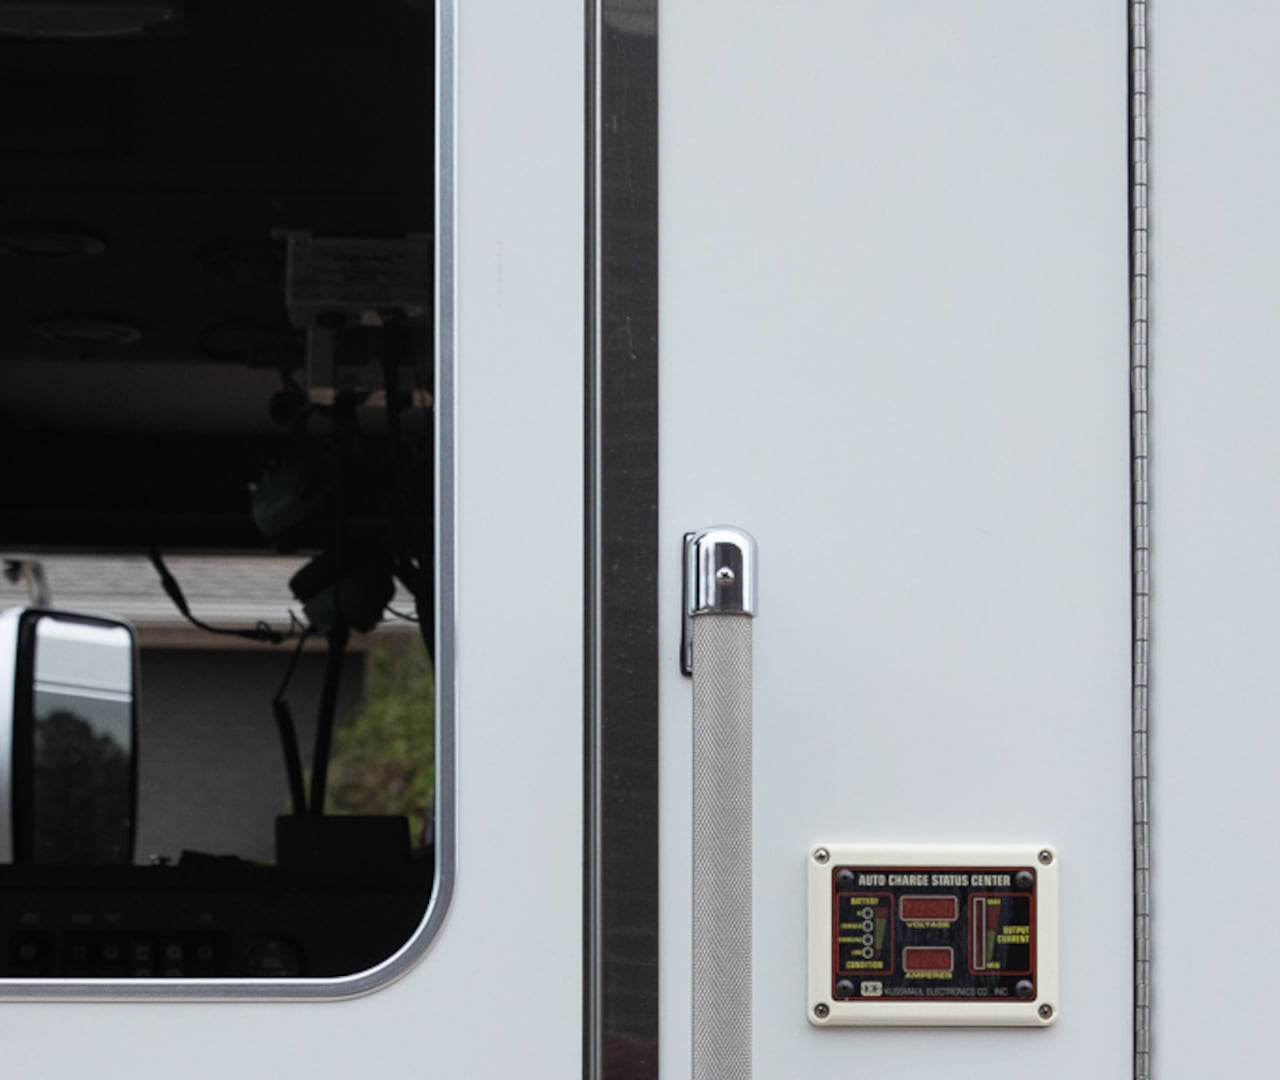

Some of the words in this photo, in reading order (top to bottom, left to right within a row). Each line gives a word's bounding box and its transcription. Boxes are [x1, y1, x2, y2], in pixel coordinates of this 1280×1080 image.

[858, 874, 887, 886] AUTO
[888, 874, 929, 886] CHARGE
[932, 874, 969, 886] STATUS
[971, 874, 1011, 886] CENTER
[905, 921, 951, 929] VOLTAGE
